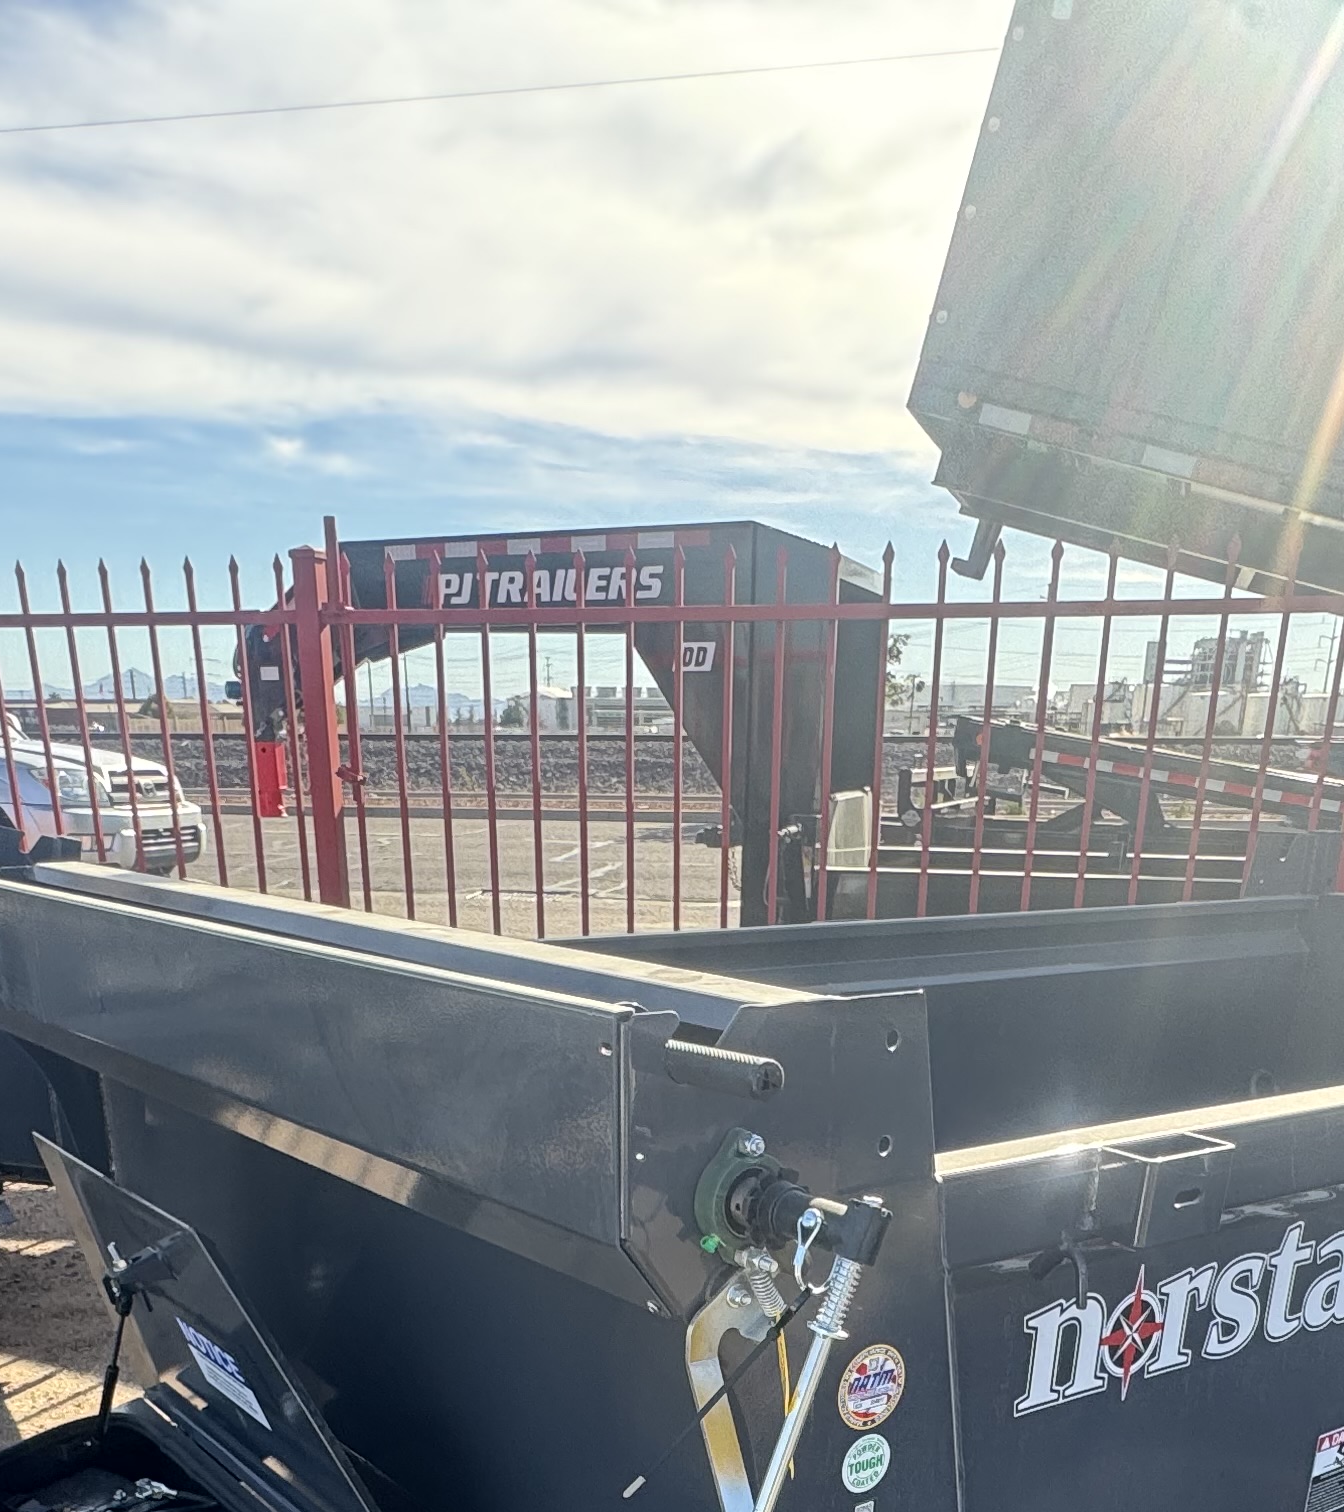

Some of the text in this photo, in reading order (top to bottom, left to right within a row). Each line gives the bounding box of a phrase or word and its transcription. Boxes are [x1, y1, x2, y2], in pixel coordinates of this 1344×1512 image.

[477, 565, 664, 603] TRAILERS
[175, 1316, 245, 1383] NOTICE
[848, 1454, 884, 1476] TOUGH
